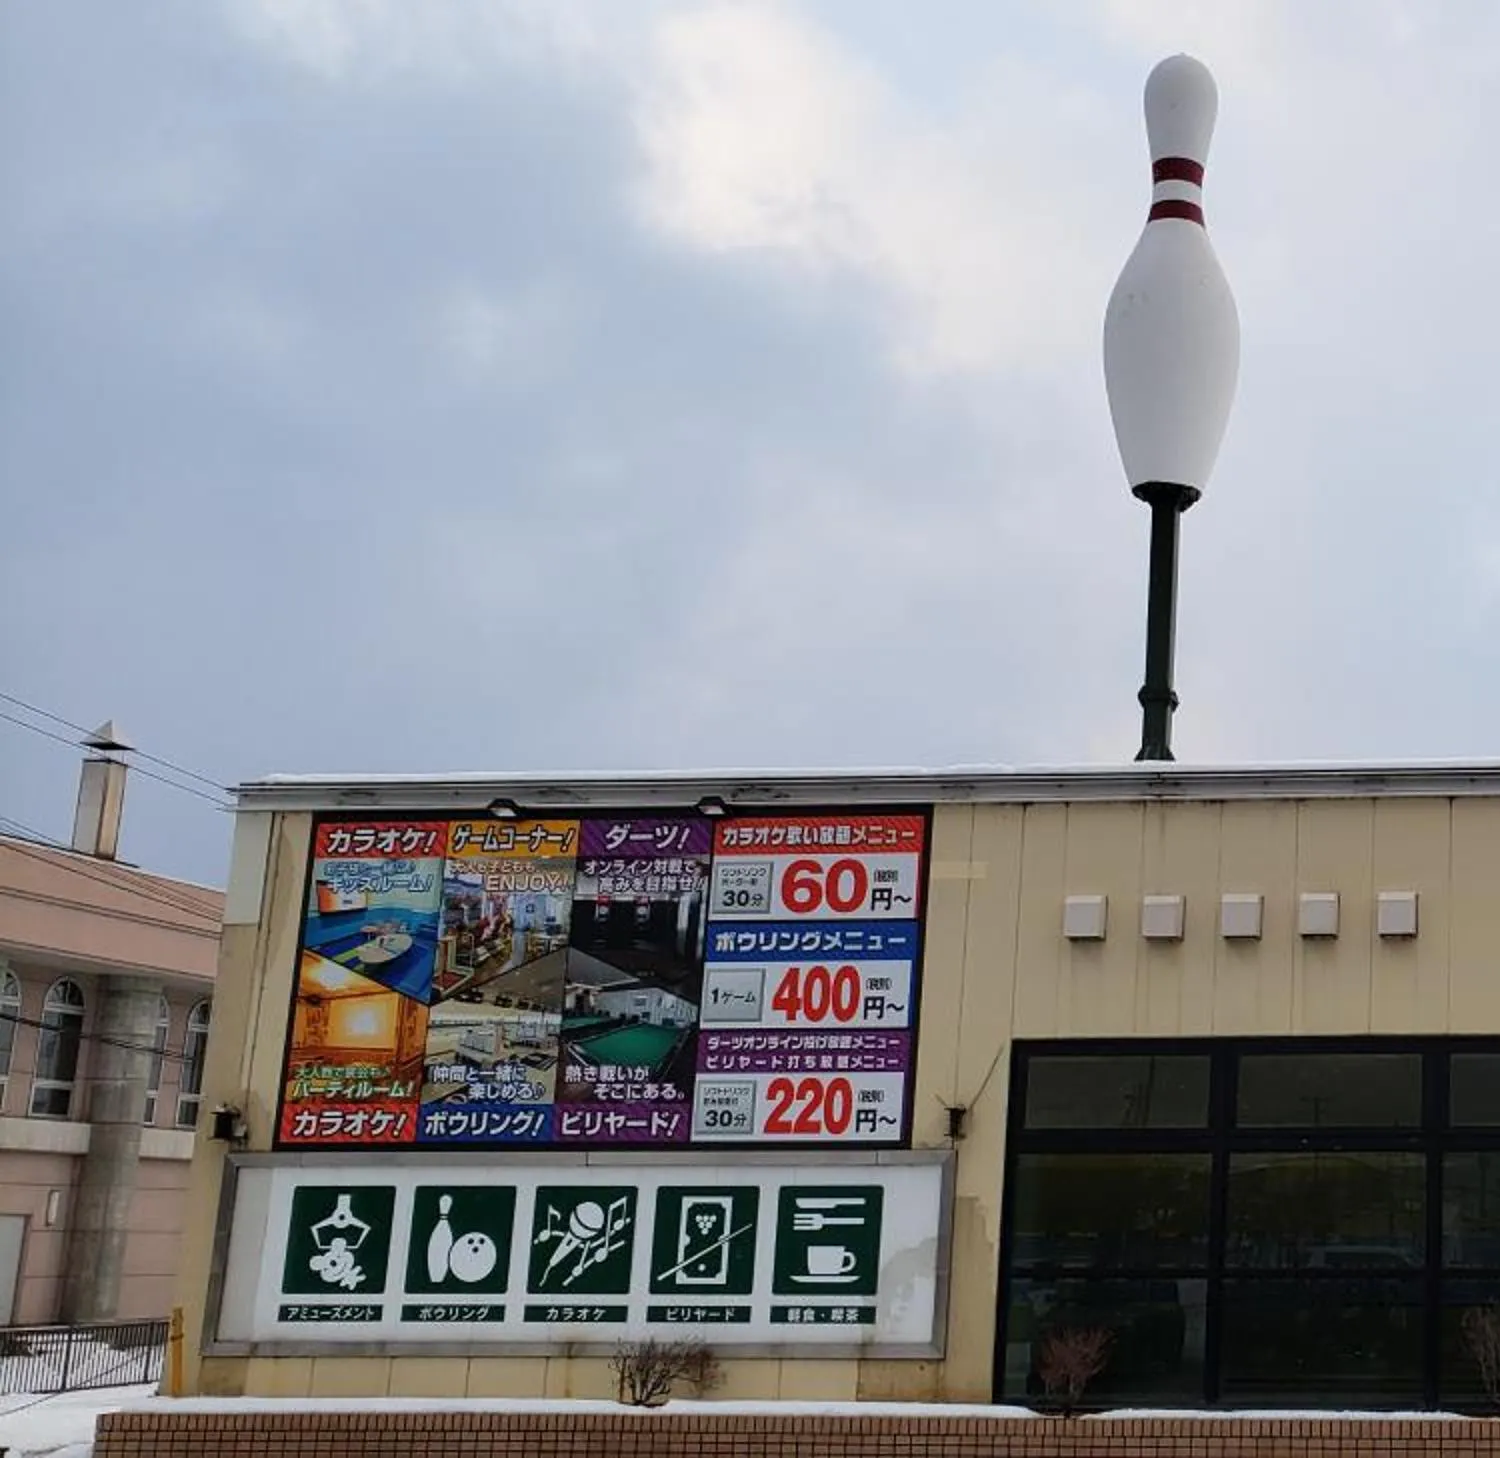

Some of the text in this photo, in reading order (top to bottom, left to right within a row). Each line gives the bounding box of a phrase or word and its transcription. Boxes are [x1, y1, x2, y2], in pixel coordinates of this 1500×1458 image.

[327, 827, 437, 853] カラオケ!
[454, 825, 574, 852] ゲームコーナー!
[606, 823, 690, 850] ダーツ!
[722, 826, 915, 846] カラオケ歌い放題メニュー
[584, 858, 696, 875] オンライン対戦で
[715, 931, 907, 952] ボウリングメニュー
[432, 1064, 527, 1083] 仲間と一緒に
[565, 1065, 650, 1083] 熱き戦いが
[292, 1109, 408, 1137] カラオケ!
[425, 1109, 545, 1137] ボウリング!
[561, 1110, 681, 1137] ビリヤード!
[286, 1306, 375, 1321] アミューズメント
[418, 1306, 491, 1320] ボウリング
[546, 1307, 607, 1320] カラオケ
[665, 1307, 736, 1320] ビリヤード
